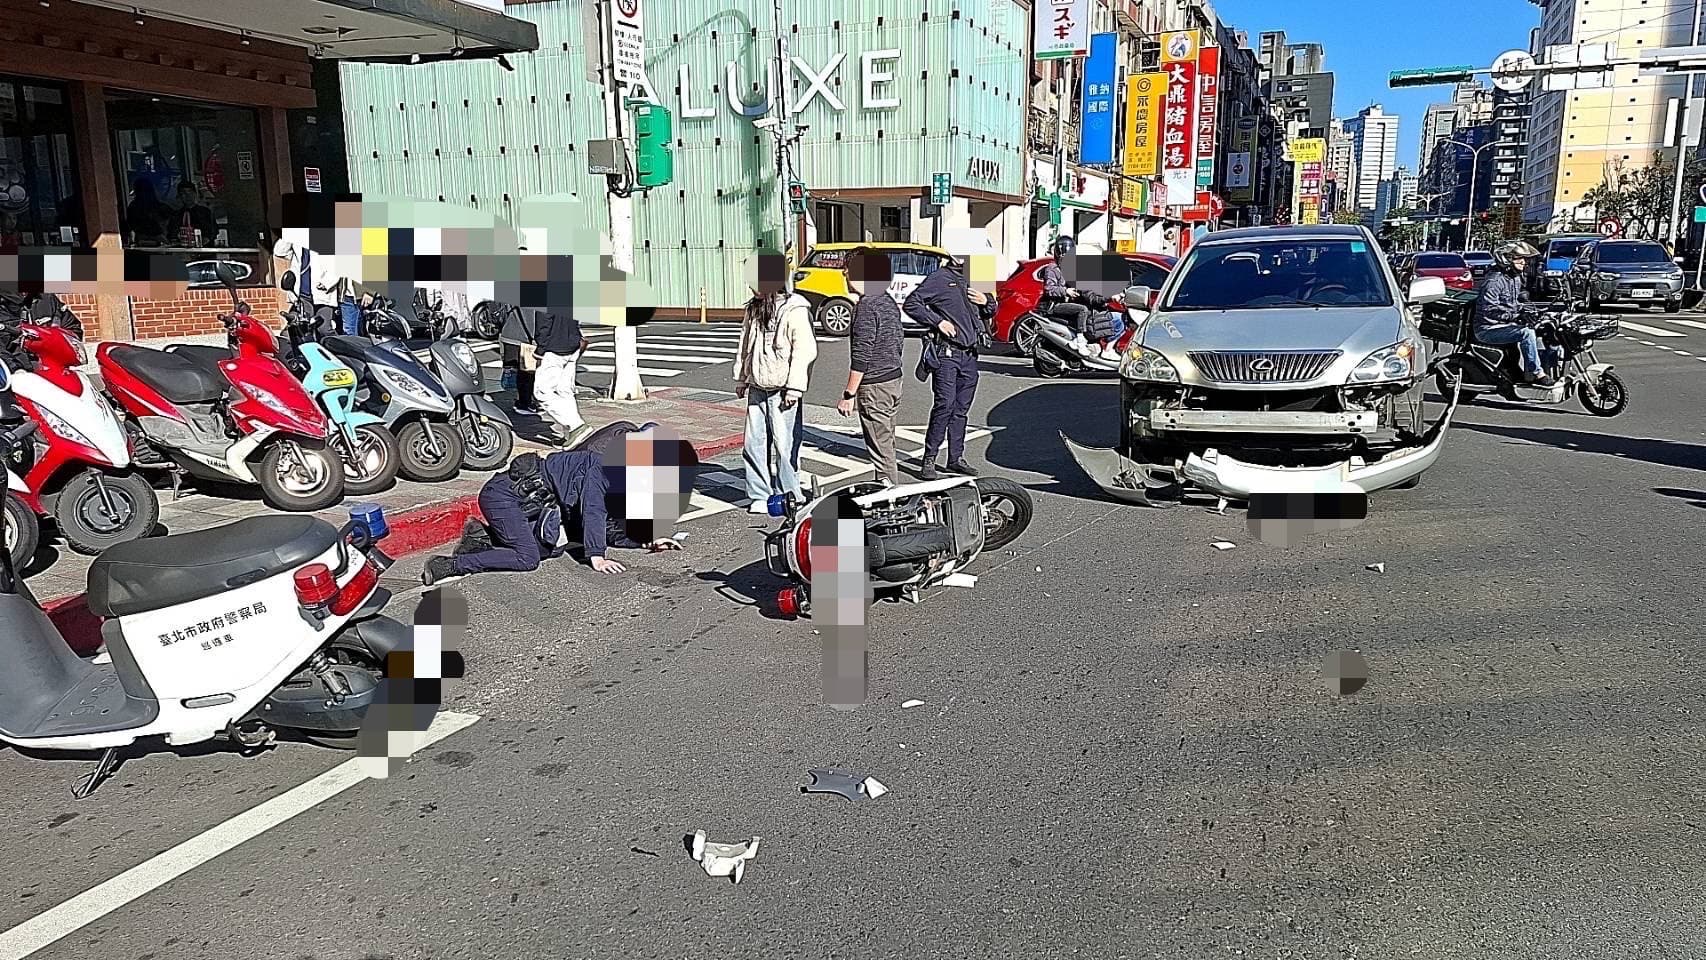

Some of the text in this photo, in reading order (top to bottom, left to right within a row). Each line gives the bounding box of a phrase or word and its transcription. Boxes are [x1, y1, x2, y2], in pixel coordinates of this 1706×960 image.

[1054, 8, 1075, 39] スギ
[1165, 64, 1190, 166] 大鼎豬血湯
[1199, 74, 1215, 153] 中信房屋
[889, 281, 908, 291] VIP
[158, 601, 267, 647] 臺北市政府警察局
